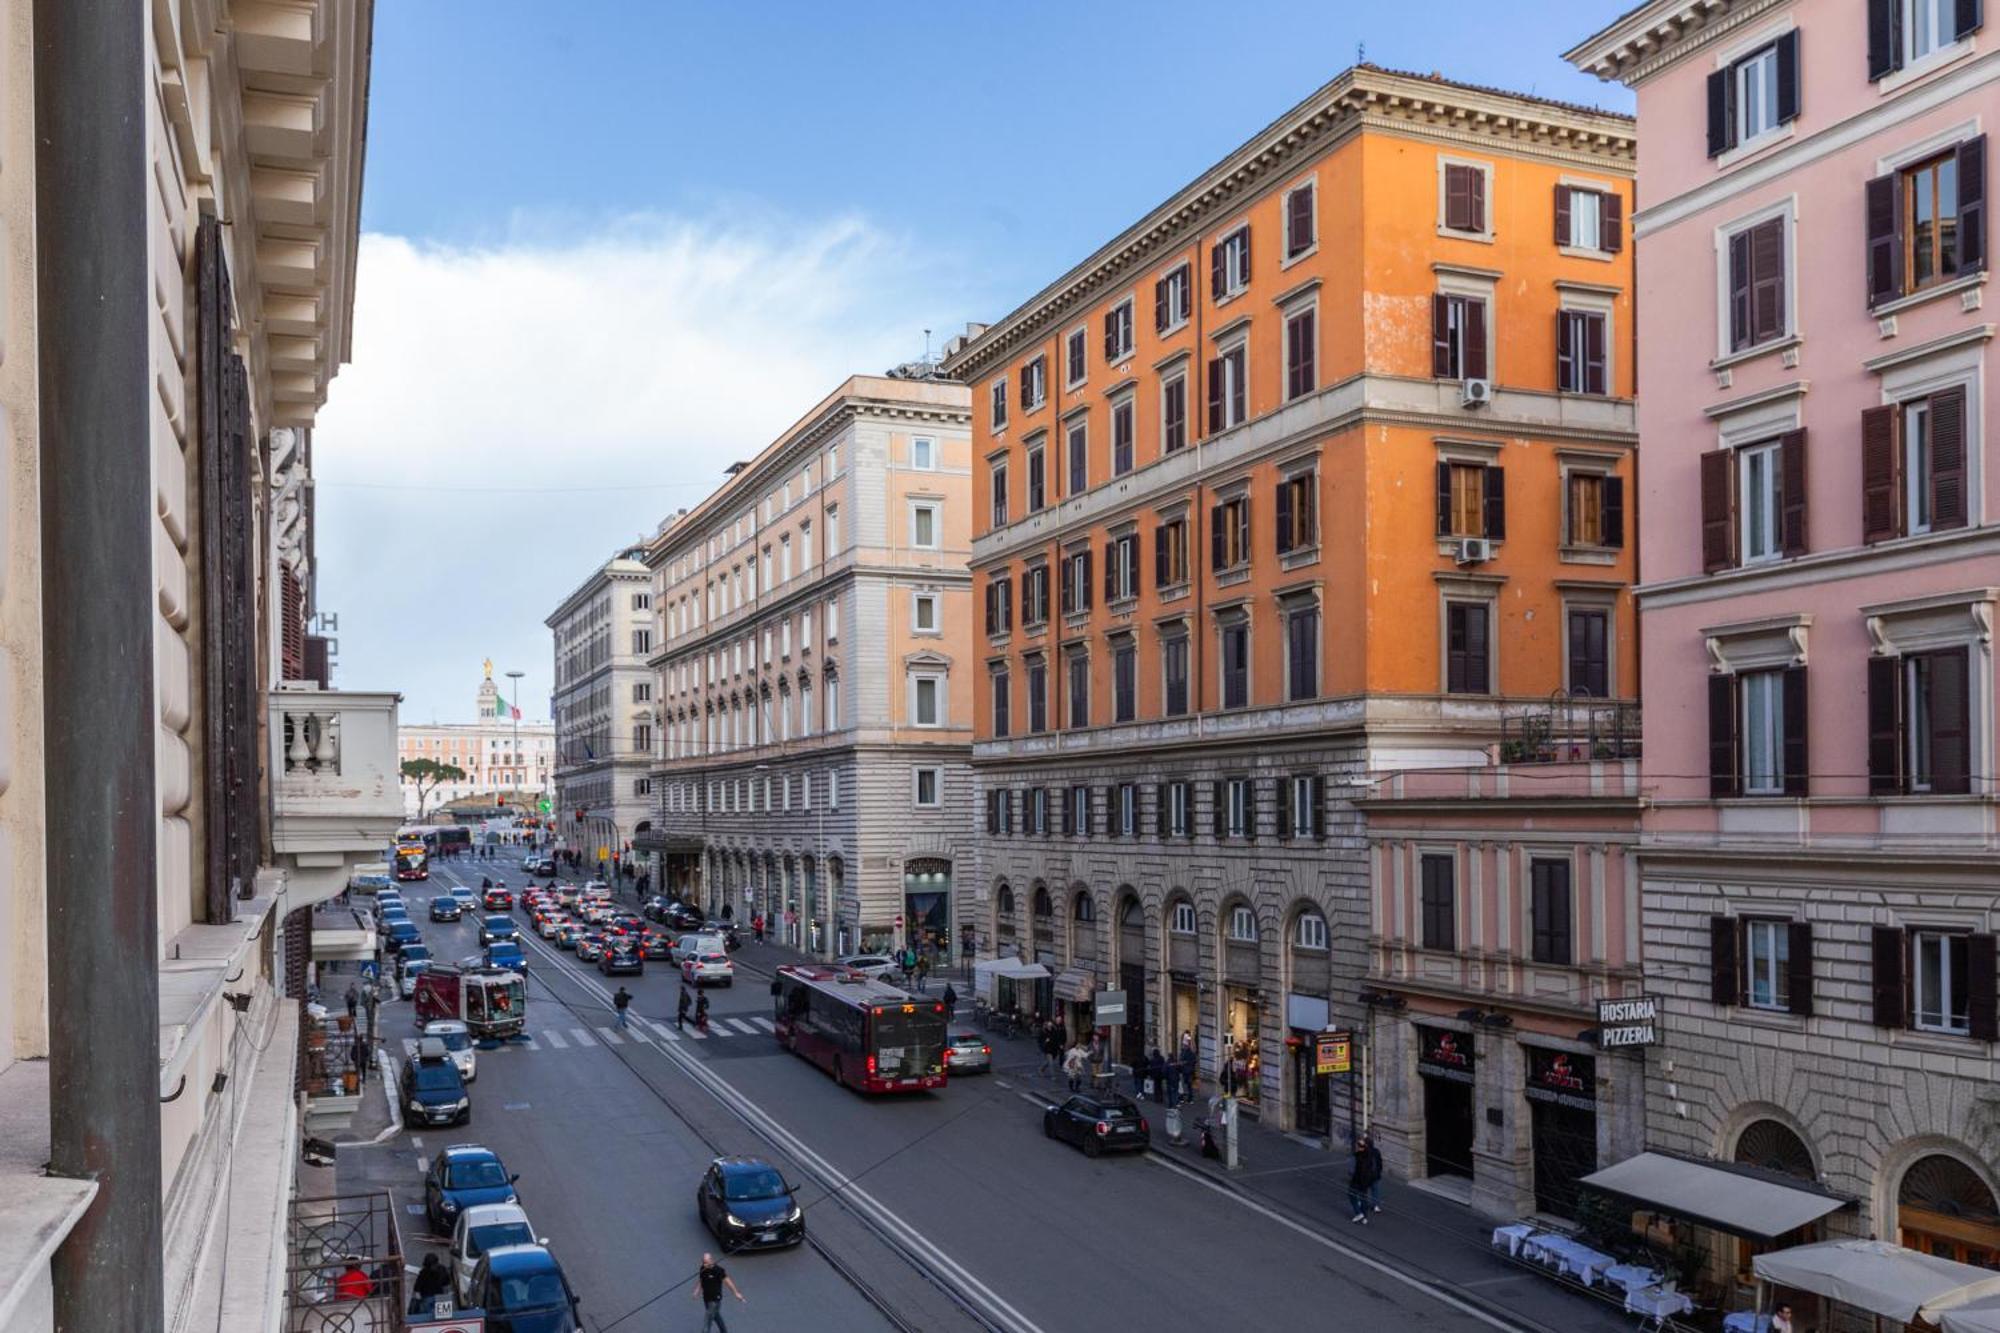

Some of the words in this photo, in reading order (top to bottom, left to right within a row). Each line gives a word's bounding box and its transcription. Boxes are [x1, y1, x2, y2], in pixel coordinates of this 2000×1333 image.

[1600, 1001, 1656, 1021] HOSTARIA
[1603, 1026, 1654, 1046] PIZZERIA
[437, 1302, 450, 1314] EM
